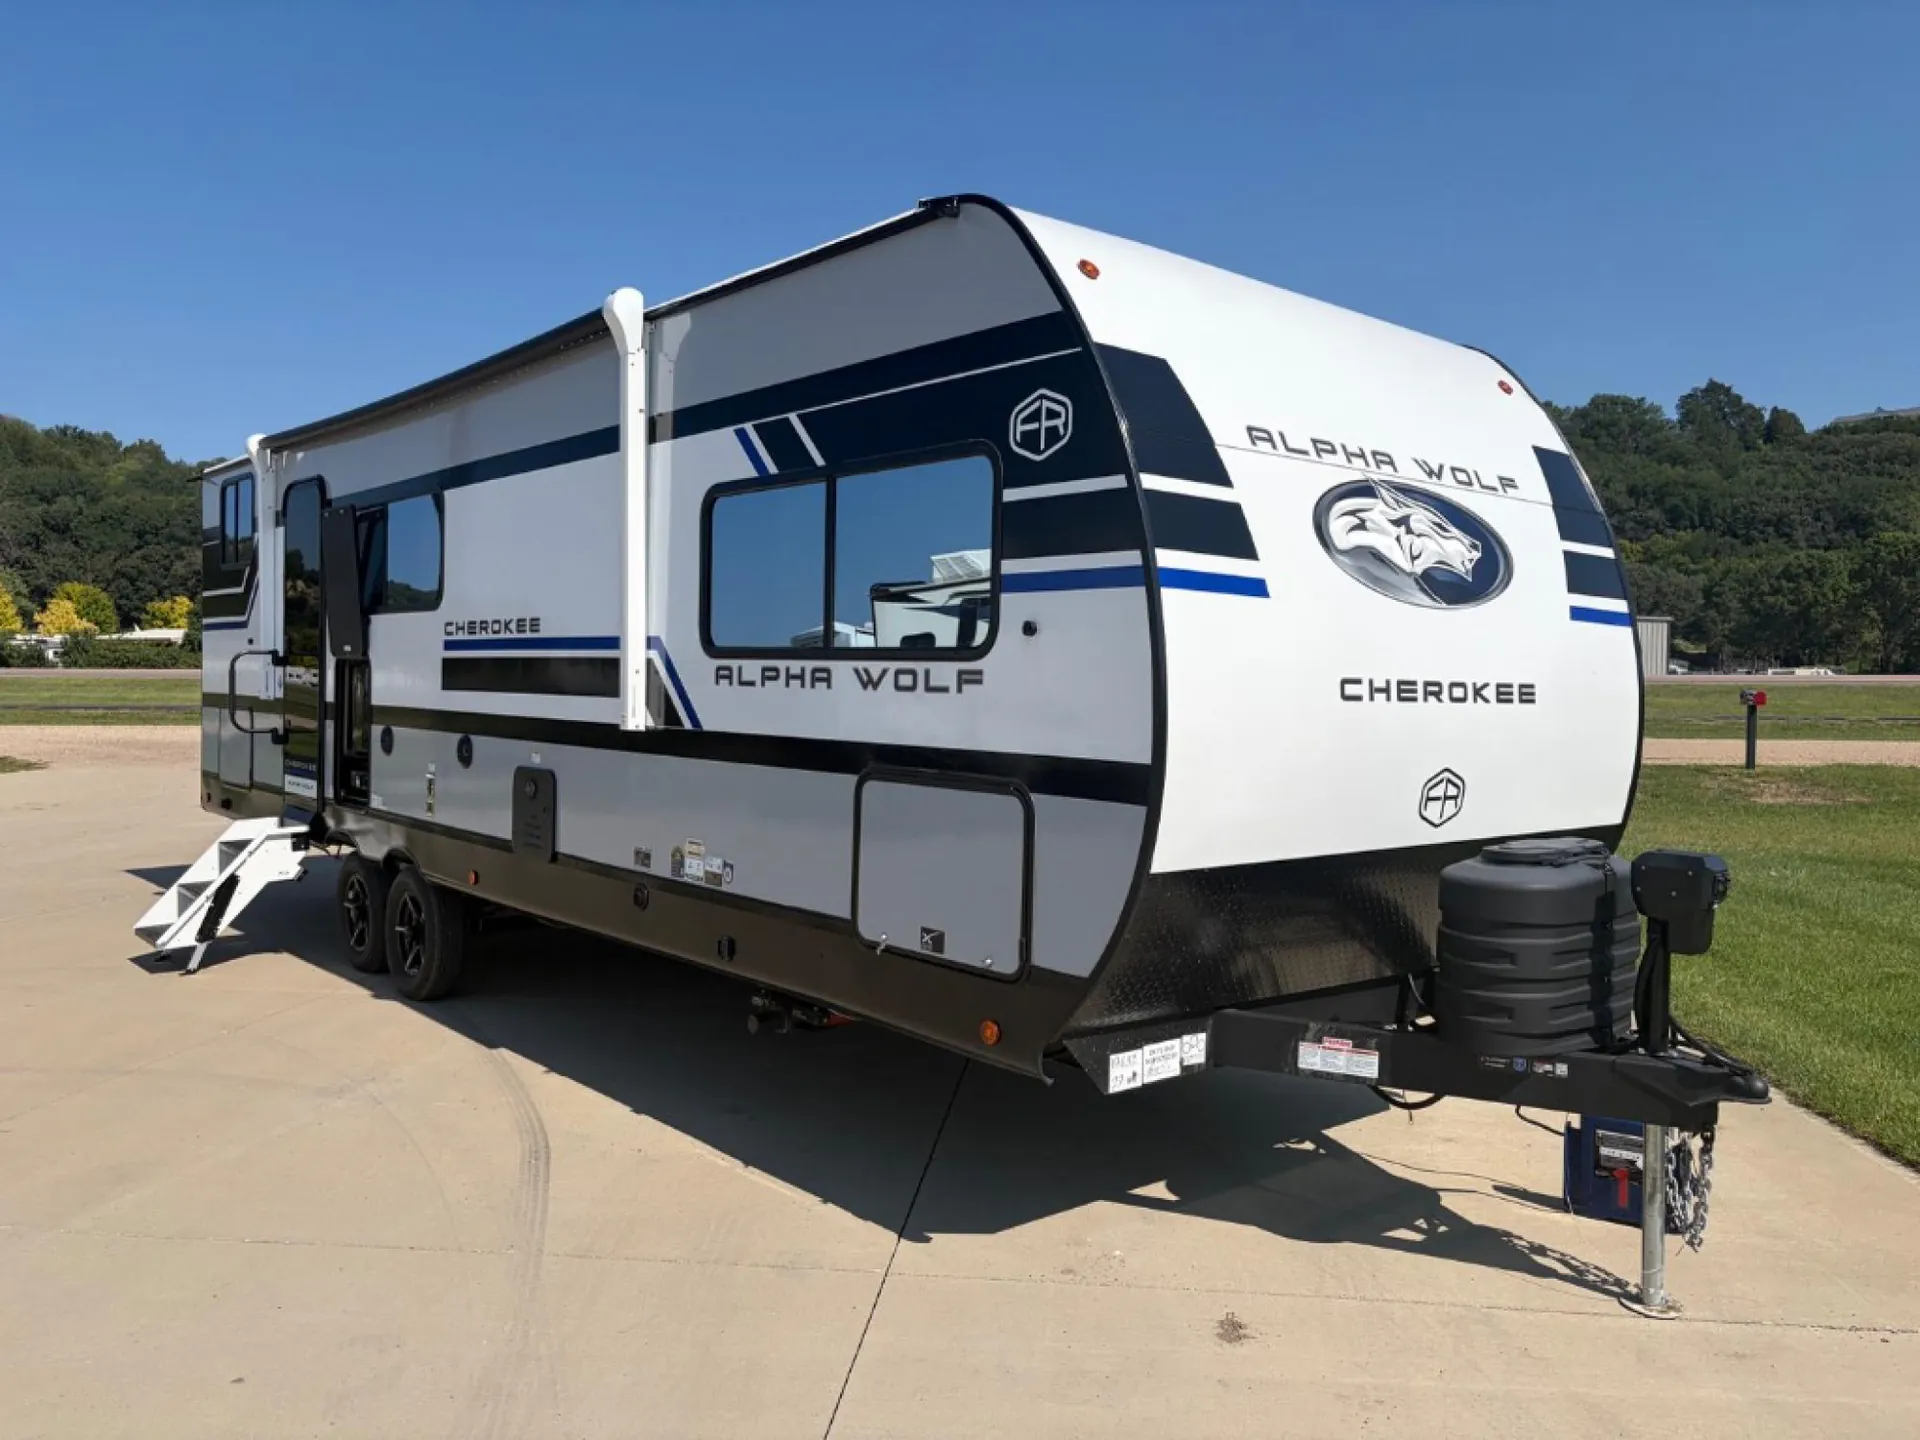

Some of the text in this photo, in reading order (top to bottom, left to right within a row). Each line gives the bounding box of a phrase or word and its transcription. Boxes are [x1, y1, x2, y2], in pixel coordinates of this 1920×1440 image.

[1246, 425, 1519, 494] ALPHA WOLF
[443, 617, 541, 636] CHEROKEE
[714, 664, 984, 694] ALPHA WOLF
[1339, 677, 1537, 705] CHEROKEE
